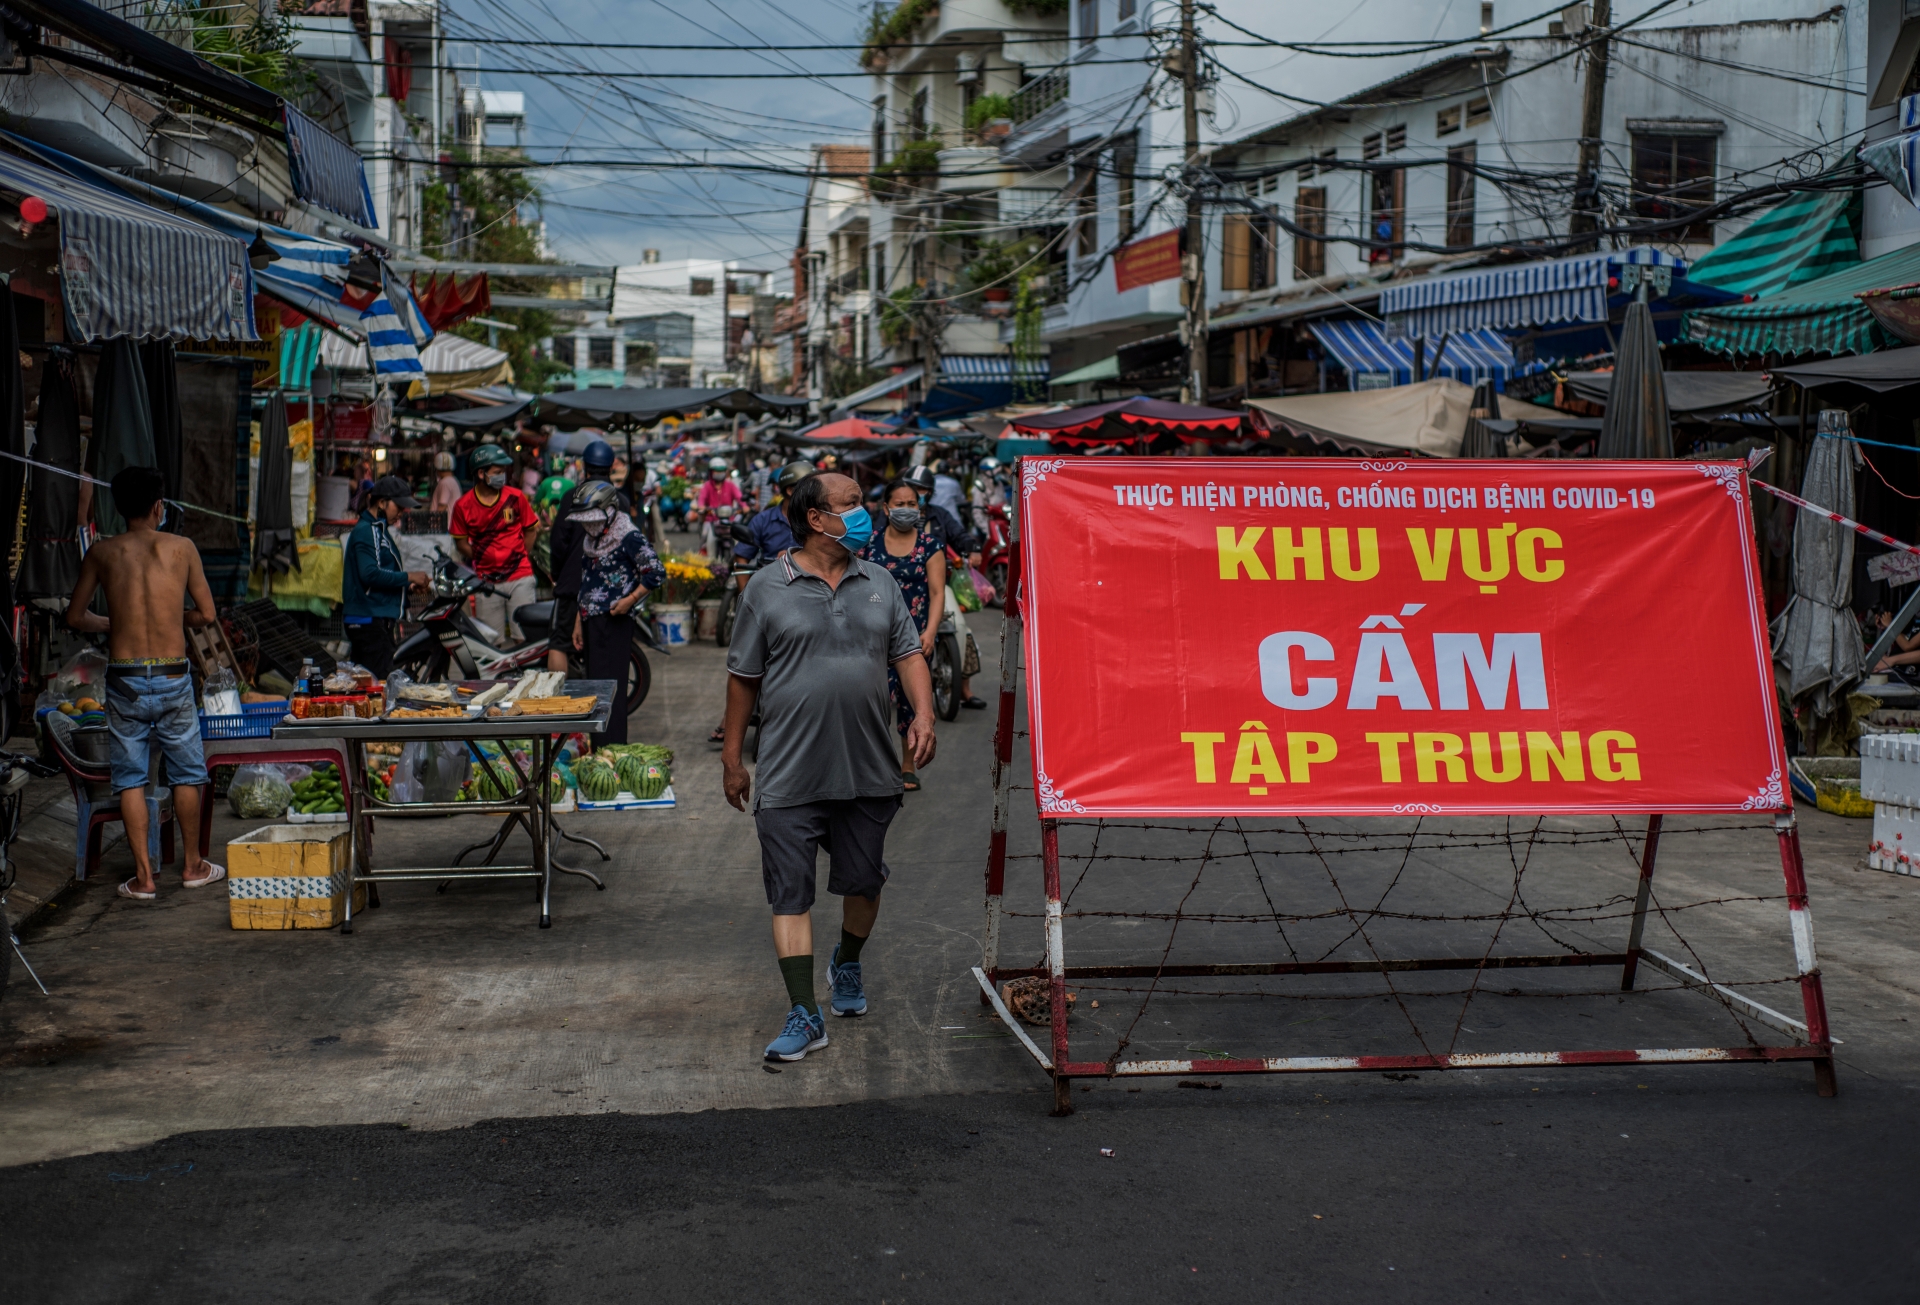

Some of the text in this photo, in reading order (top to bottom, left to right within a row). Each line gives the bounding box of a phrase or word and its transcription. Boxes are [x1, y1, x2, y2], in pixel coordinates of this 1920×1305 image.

[1113, 479, 1656, 513] THỰC HIỆN PHÒNG, CHỐNG DỊCH BỆNH COVID-19
[1216, 522, 1566, 594] KHU VỰC
[1258, 603, 1549, 711] CẤM
[1181, 720, 1642, 796] TẬP TRUNG
